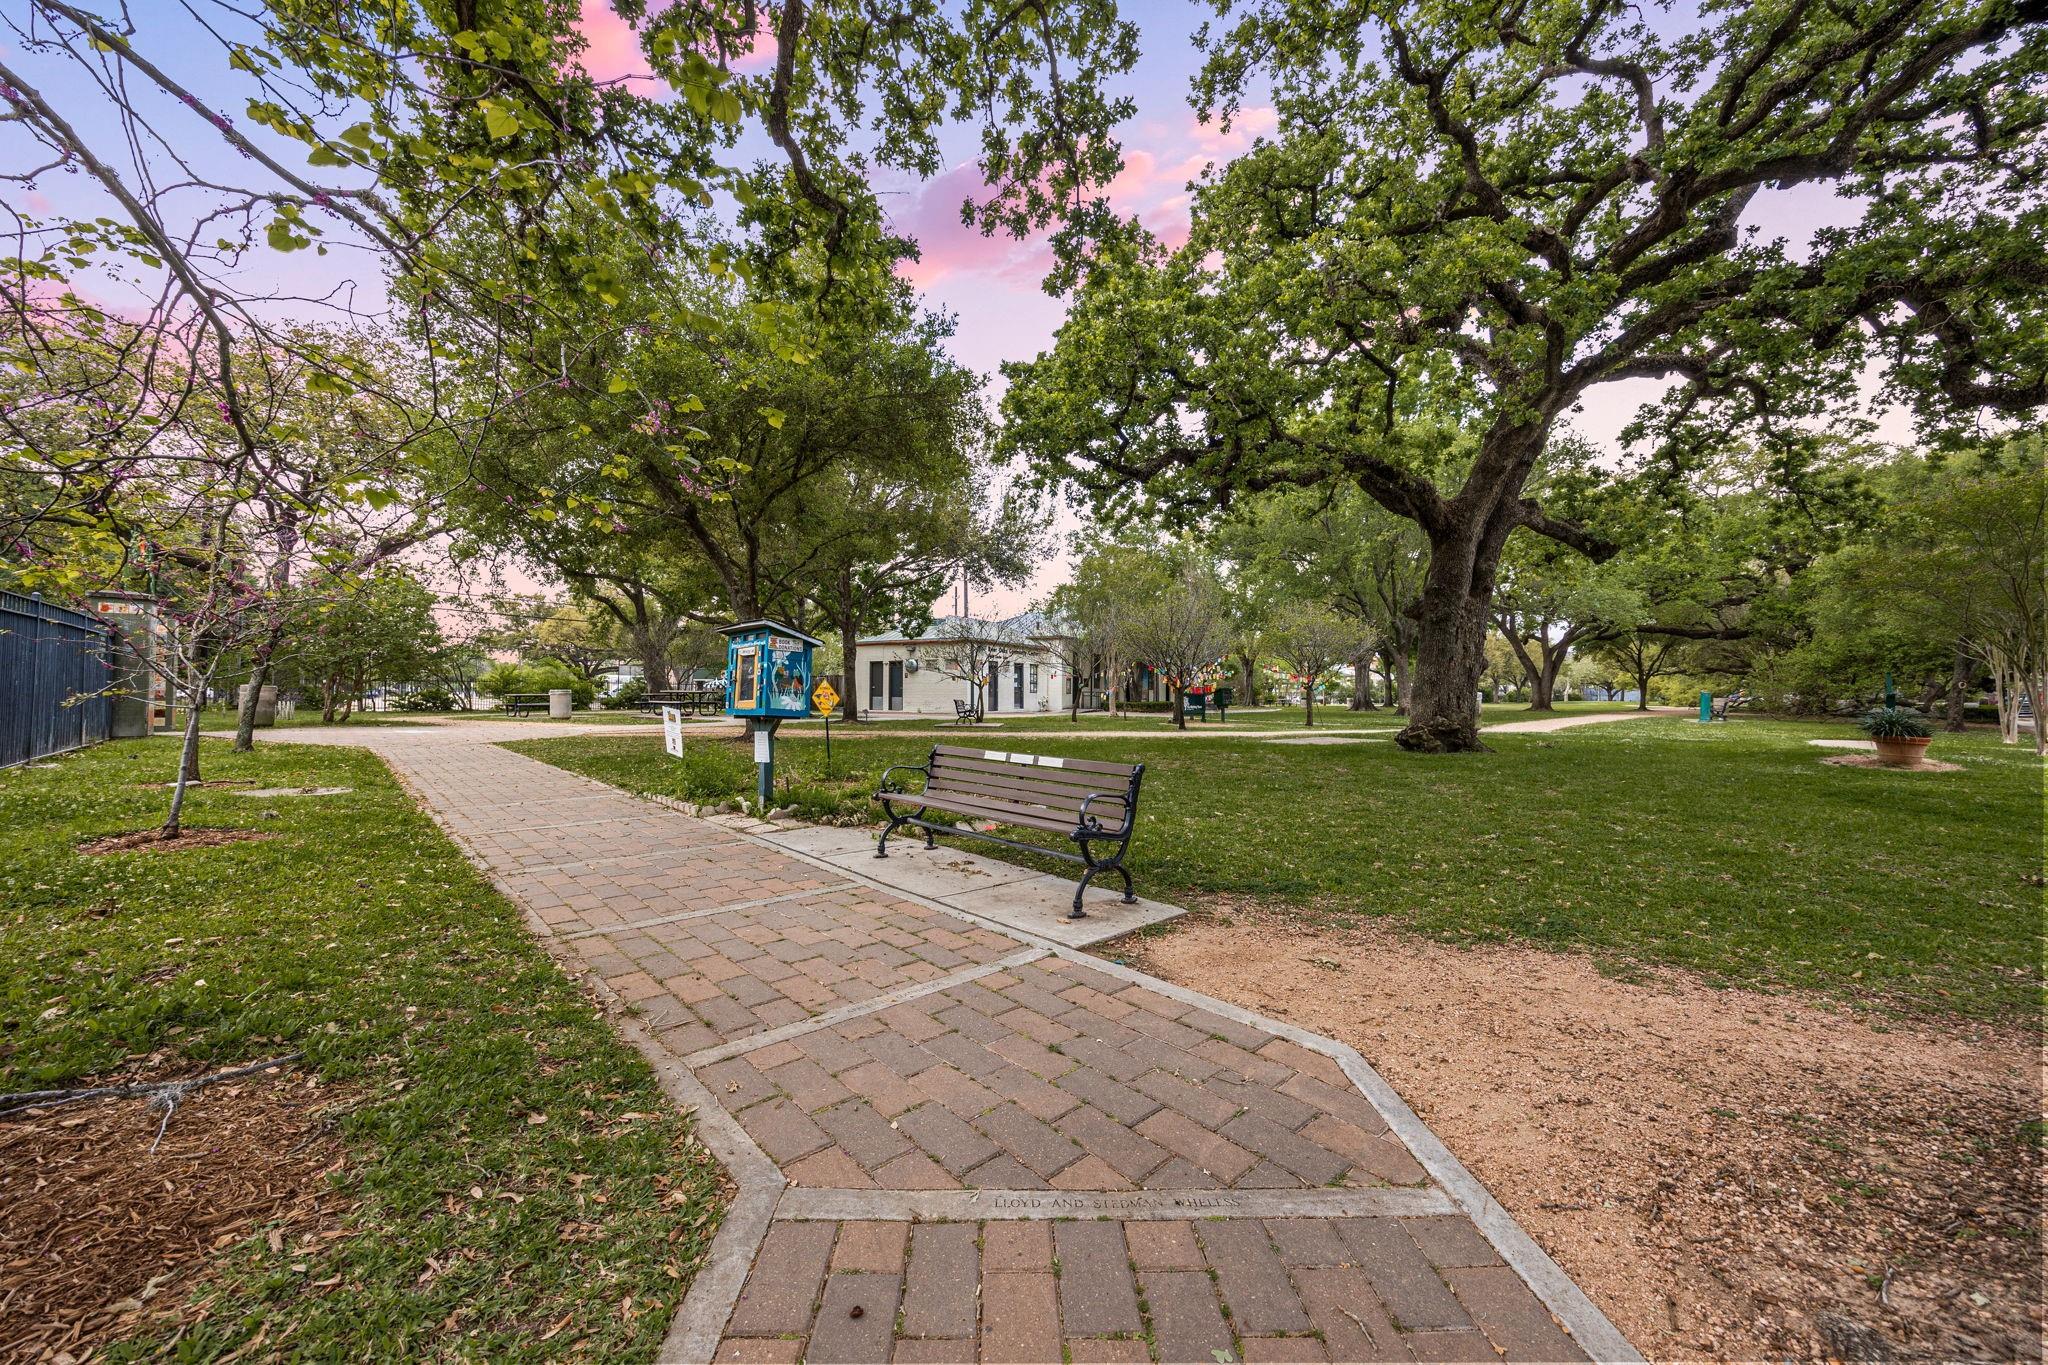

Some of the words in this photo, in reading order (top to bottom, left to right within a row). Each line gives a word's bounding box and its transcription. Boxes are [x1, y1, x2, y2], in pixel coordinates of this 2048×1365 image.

[994, 1197, 1041, 1208] LLOYD
[1052, 1198, 1084, 1208] AND
[1094, 1198, 1163, 1209] STEDMAN
[1173, 1198, 1241, 1208] WHELESS
